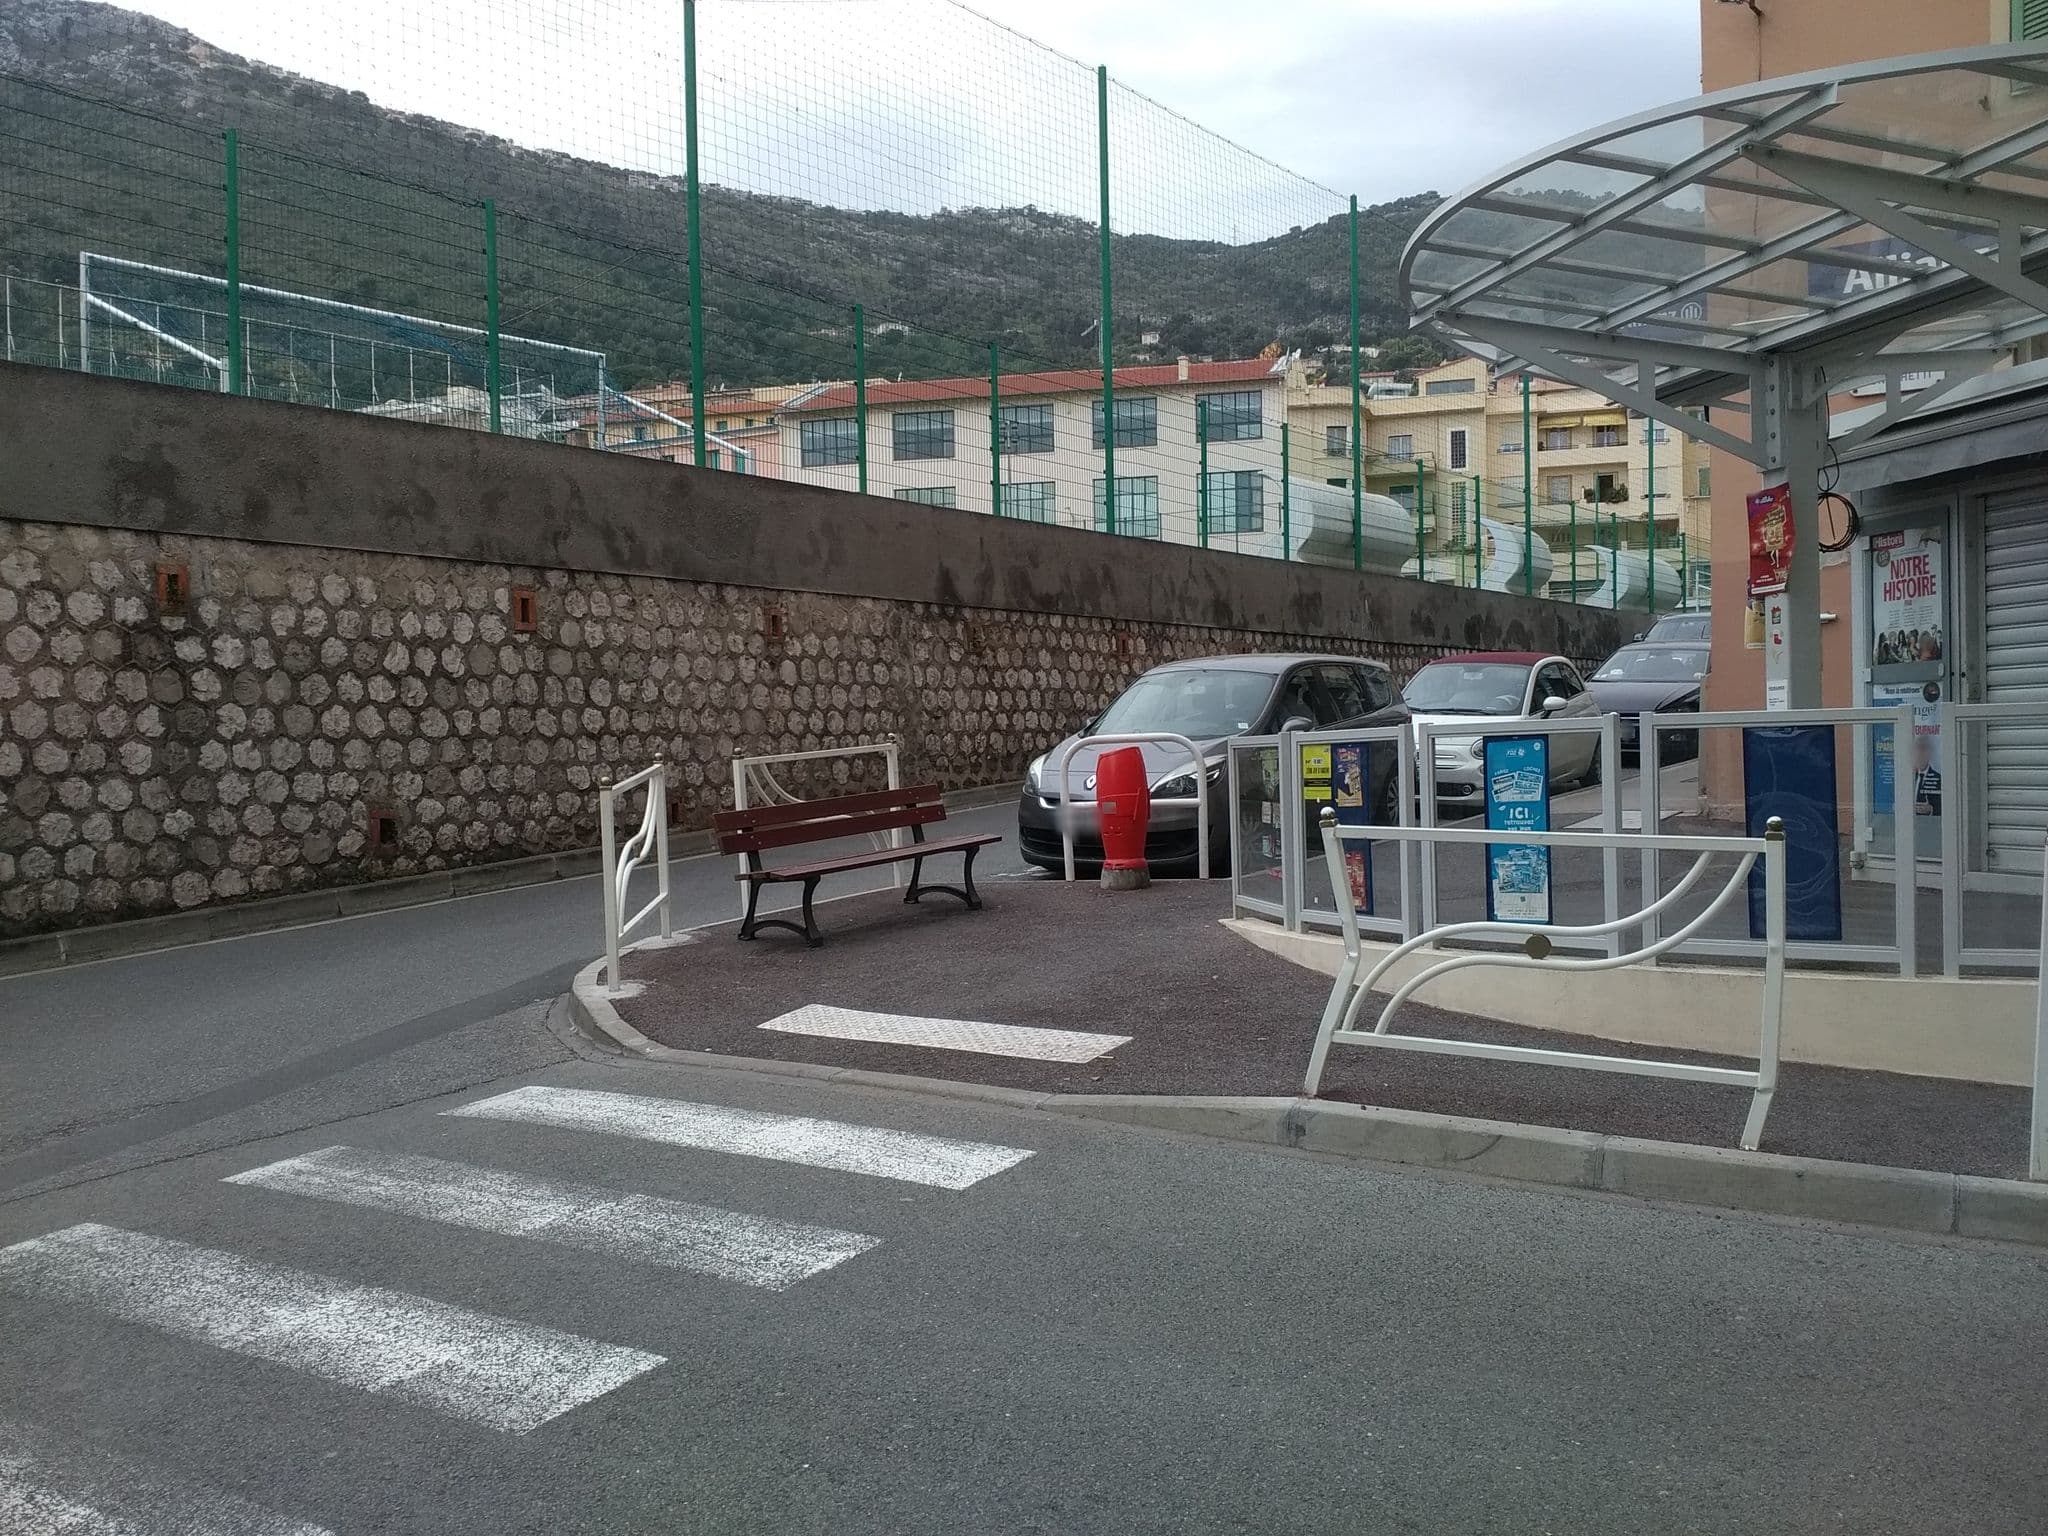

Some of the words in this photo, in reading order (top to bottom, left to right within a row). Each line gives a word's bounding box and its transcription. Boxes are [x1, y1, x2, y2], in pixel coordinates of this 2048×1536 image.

[1890, 554, 1930, 580] NOTRE
[1883, 575, 1937, 602] HISTOIRE
[1509, 807, 1529, 819] ICI
